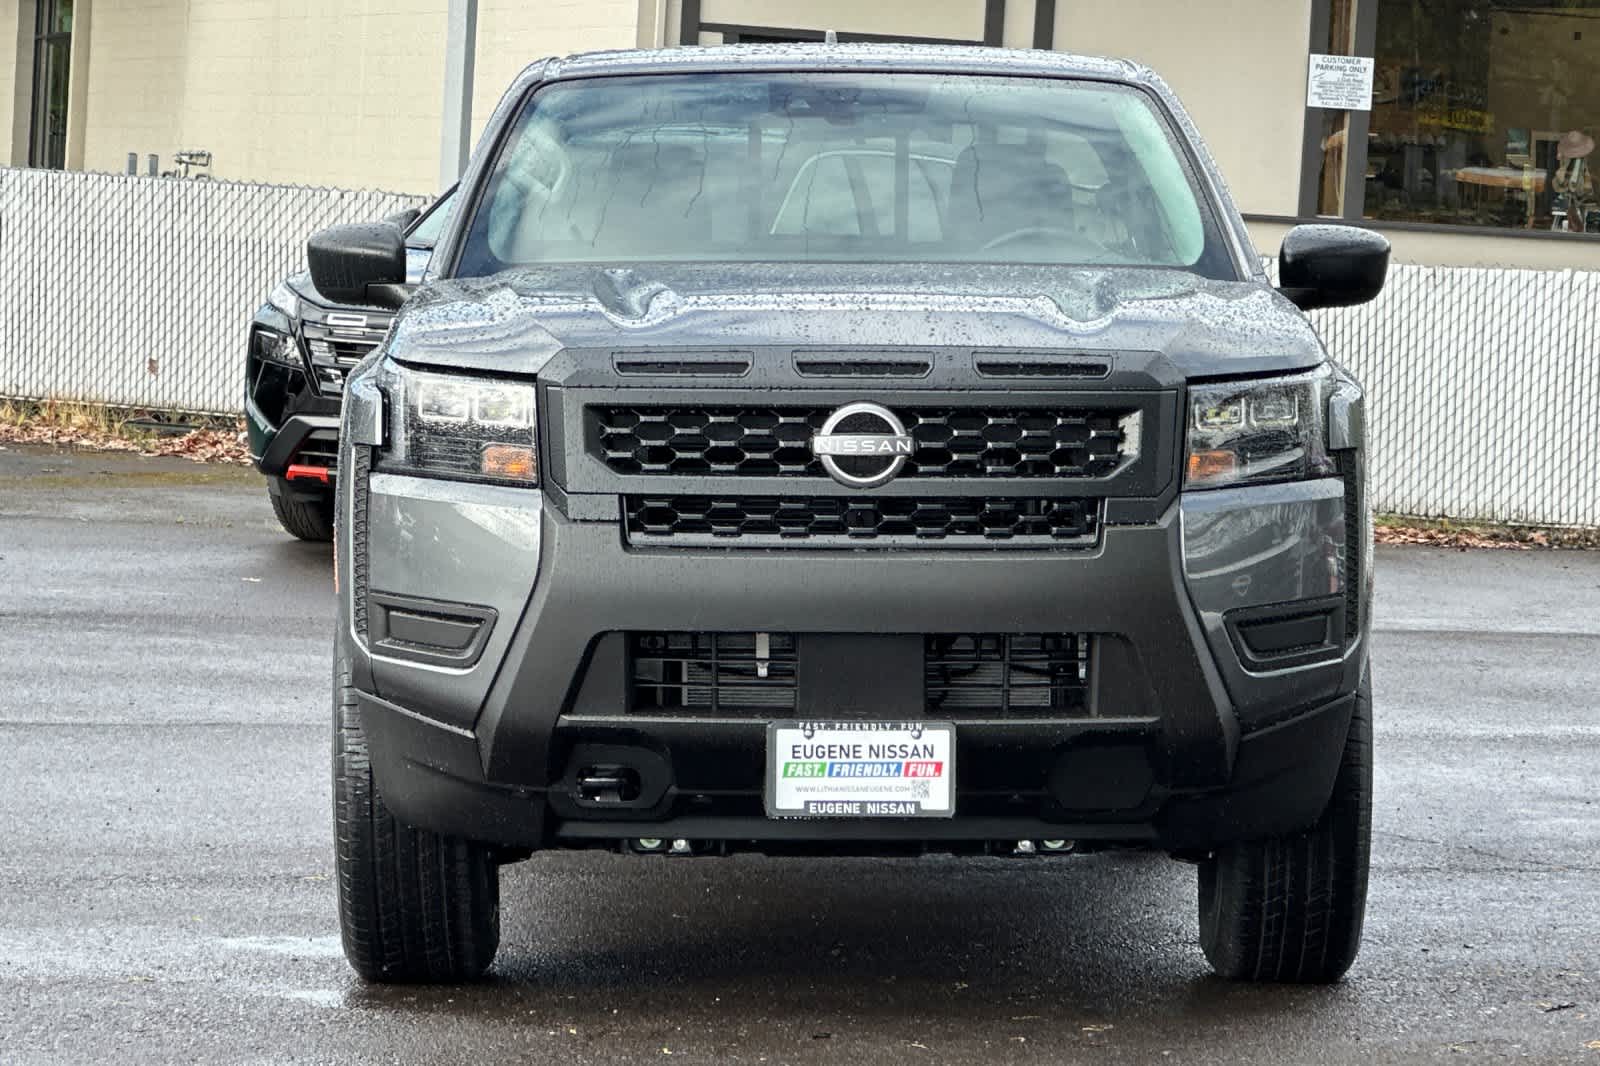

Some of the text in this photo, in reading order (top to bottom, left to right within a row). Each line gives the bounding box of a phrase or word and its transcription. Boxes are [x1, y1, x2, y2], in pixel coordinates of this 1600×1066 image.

[1315, 64, 1367, 73] PARKING ONLY
[816, 439, 911, 452] NISSAN
[792, 744, 934, 759] EUGENE NISSAN
[787, 763, 939, 776] FAST. FRIENDLY. FUN.
[809, 802, 915, 814] EUGENE NISSAN
